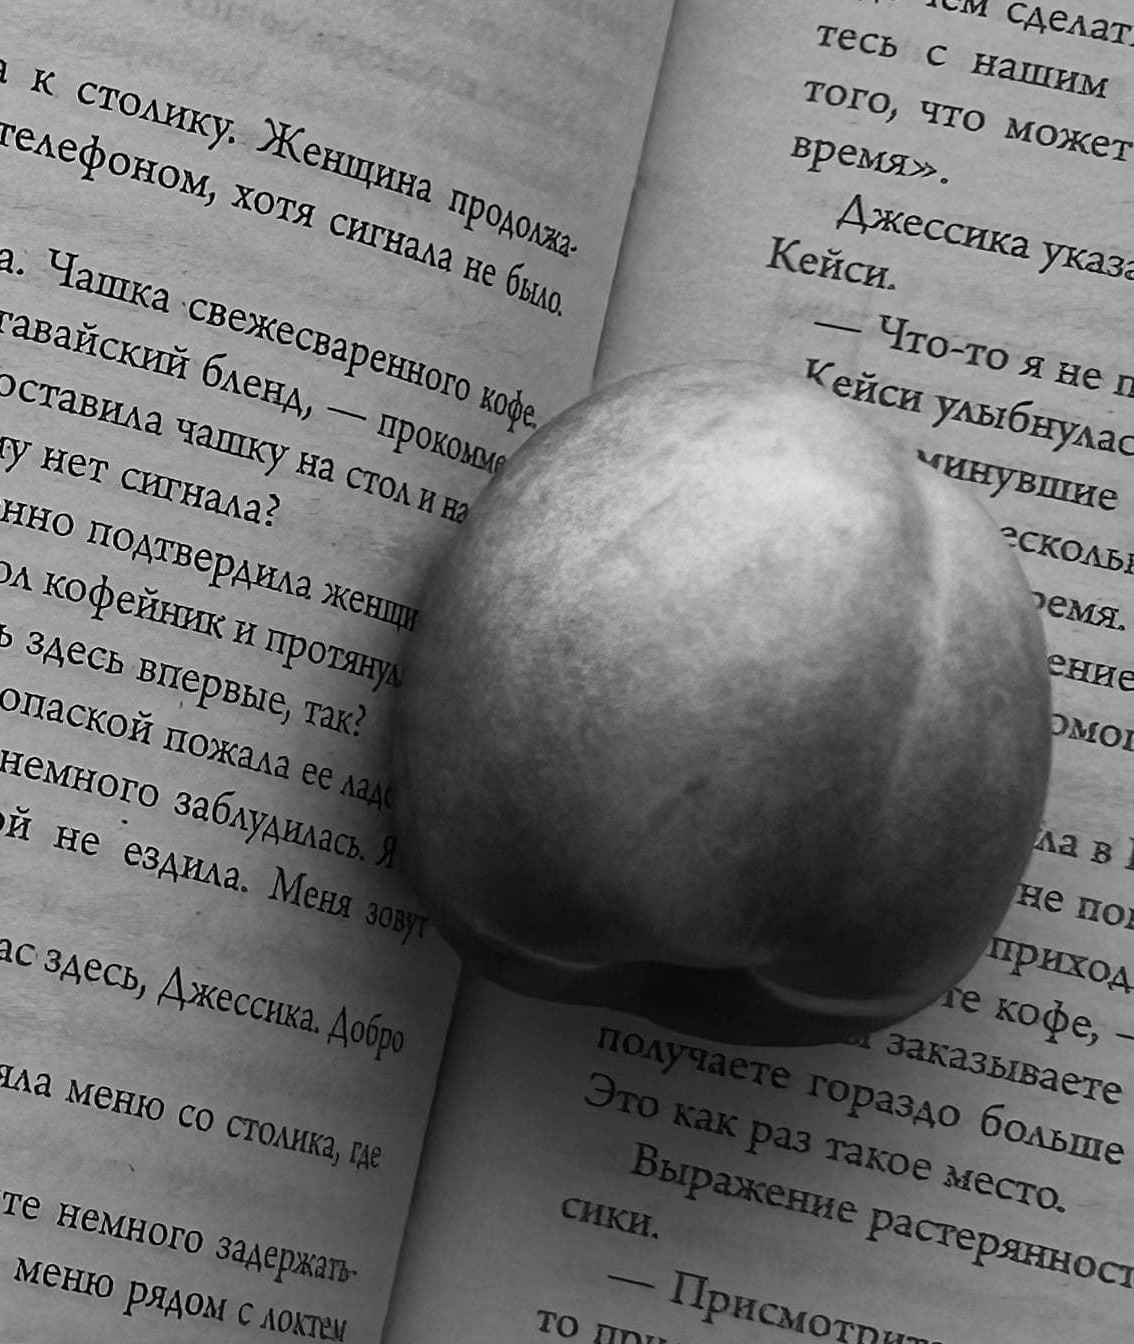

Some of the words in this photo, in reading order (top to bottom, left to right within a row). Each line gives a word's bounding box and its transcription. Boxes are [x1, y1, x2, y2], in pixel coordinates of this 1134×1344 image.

[816, 24, 898, 58] тесь
[970, 52, 1110, 100] нашим
[803, 80, 898, 124] того,
[920, 100, 986, 132] что
[77, 81, 236, 151] столику.
[255, 117, 432, 204] Женщина
[447, 188, 578, 258] продолжа-
[789, 135, 949, 185] время».
[230, 183, 317, 229] хотя
[329, 213, 453, 273] сигнала
[462, 255, 497, 287] не
[505, 262, 563, 317] было.
[765, 235, 896, 291] Кейси.
[835, 193, 1031, 260] Джессика
[48, 247, 170, 314] Чашка
[188, 298, 471, 402] свежесваренного
[878, 313, 1010, 371] Что-то
[1053, 360, 1104, 391] не
[202, 352, 313, 422] бленд,
[39, 446, 110, 484] нет
[120, 467, 281, 527] сигнала?
[176, 417, 291, 477] чашку
[346, 466, 412, 507] стол
[86, 520, 312, 601] подтвердила
[41, 569, 228, 641] кофейник
[25, 631, 125, 675] здесь
[135, 657, 291, 726] впервые,
[304, 700, 367, 737] так?
[162, 726, 290, 780] пожала
[173, 790, 366, 862] заблудилась.
[123, 842, 249, 894] ездила.
[266, 865, 354, 919] Меня
[43, 948, 147, 1001] здесь,
[156, 965, 320, 1034] Джессика.
[326, 1005, 405, 1062] Добро
[994, 997, 1100, 1047] кофе,
[596, 1026, 792, 1090] получаете
[806, 1073, 961, 1129] гораздо
[980, 1103, 1125, 1166] больше
[885, 1032, 1123, 1105] заказываете
[64, 1079, 165, 1121] меню
[178, 1104, 215, 1133] со
[226, 1115, 341, 1169] столика,
[583, 1071, 660, 1119] Это
[672, 1102, 739, 1138] как
[744, 1119, 812, 1156] раз
[825, 1137, 932, 1181] такое
[942, 1164, 1066, 1214] место.
[561, 1197, 659, 1240] сики.
[628, 1141, 859, 1224] Выражение
[56, 1202, 204, 1254] немного
[13, 1256, 114, 1298] меню
[122, 1280, 228, 1323] рядом
[536, 1309, 579, 1339] то
